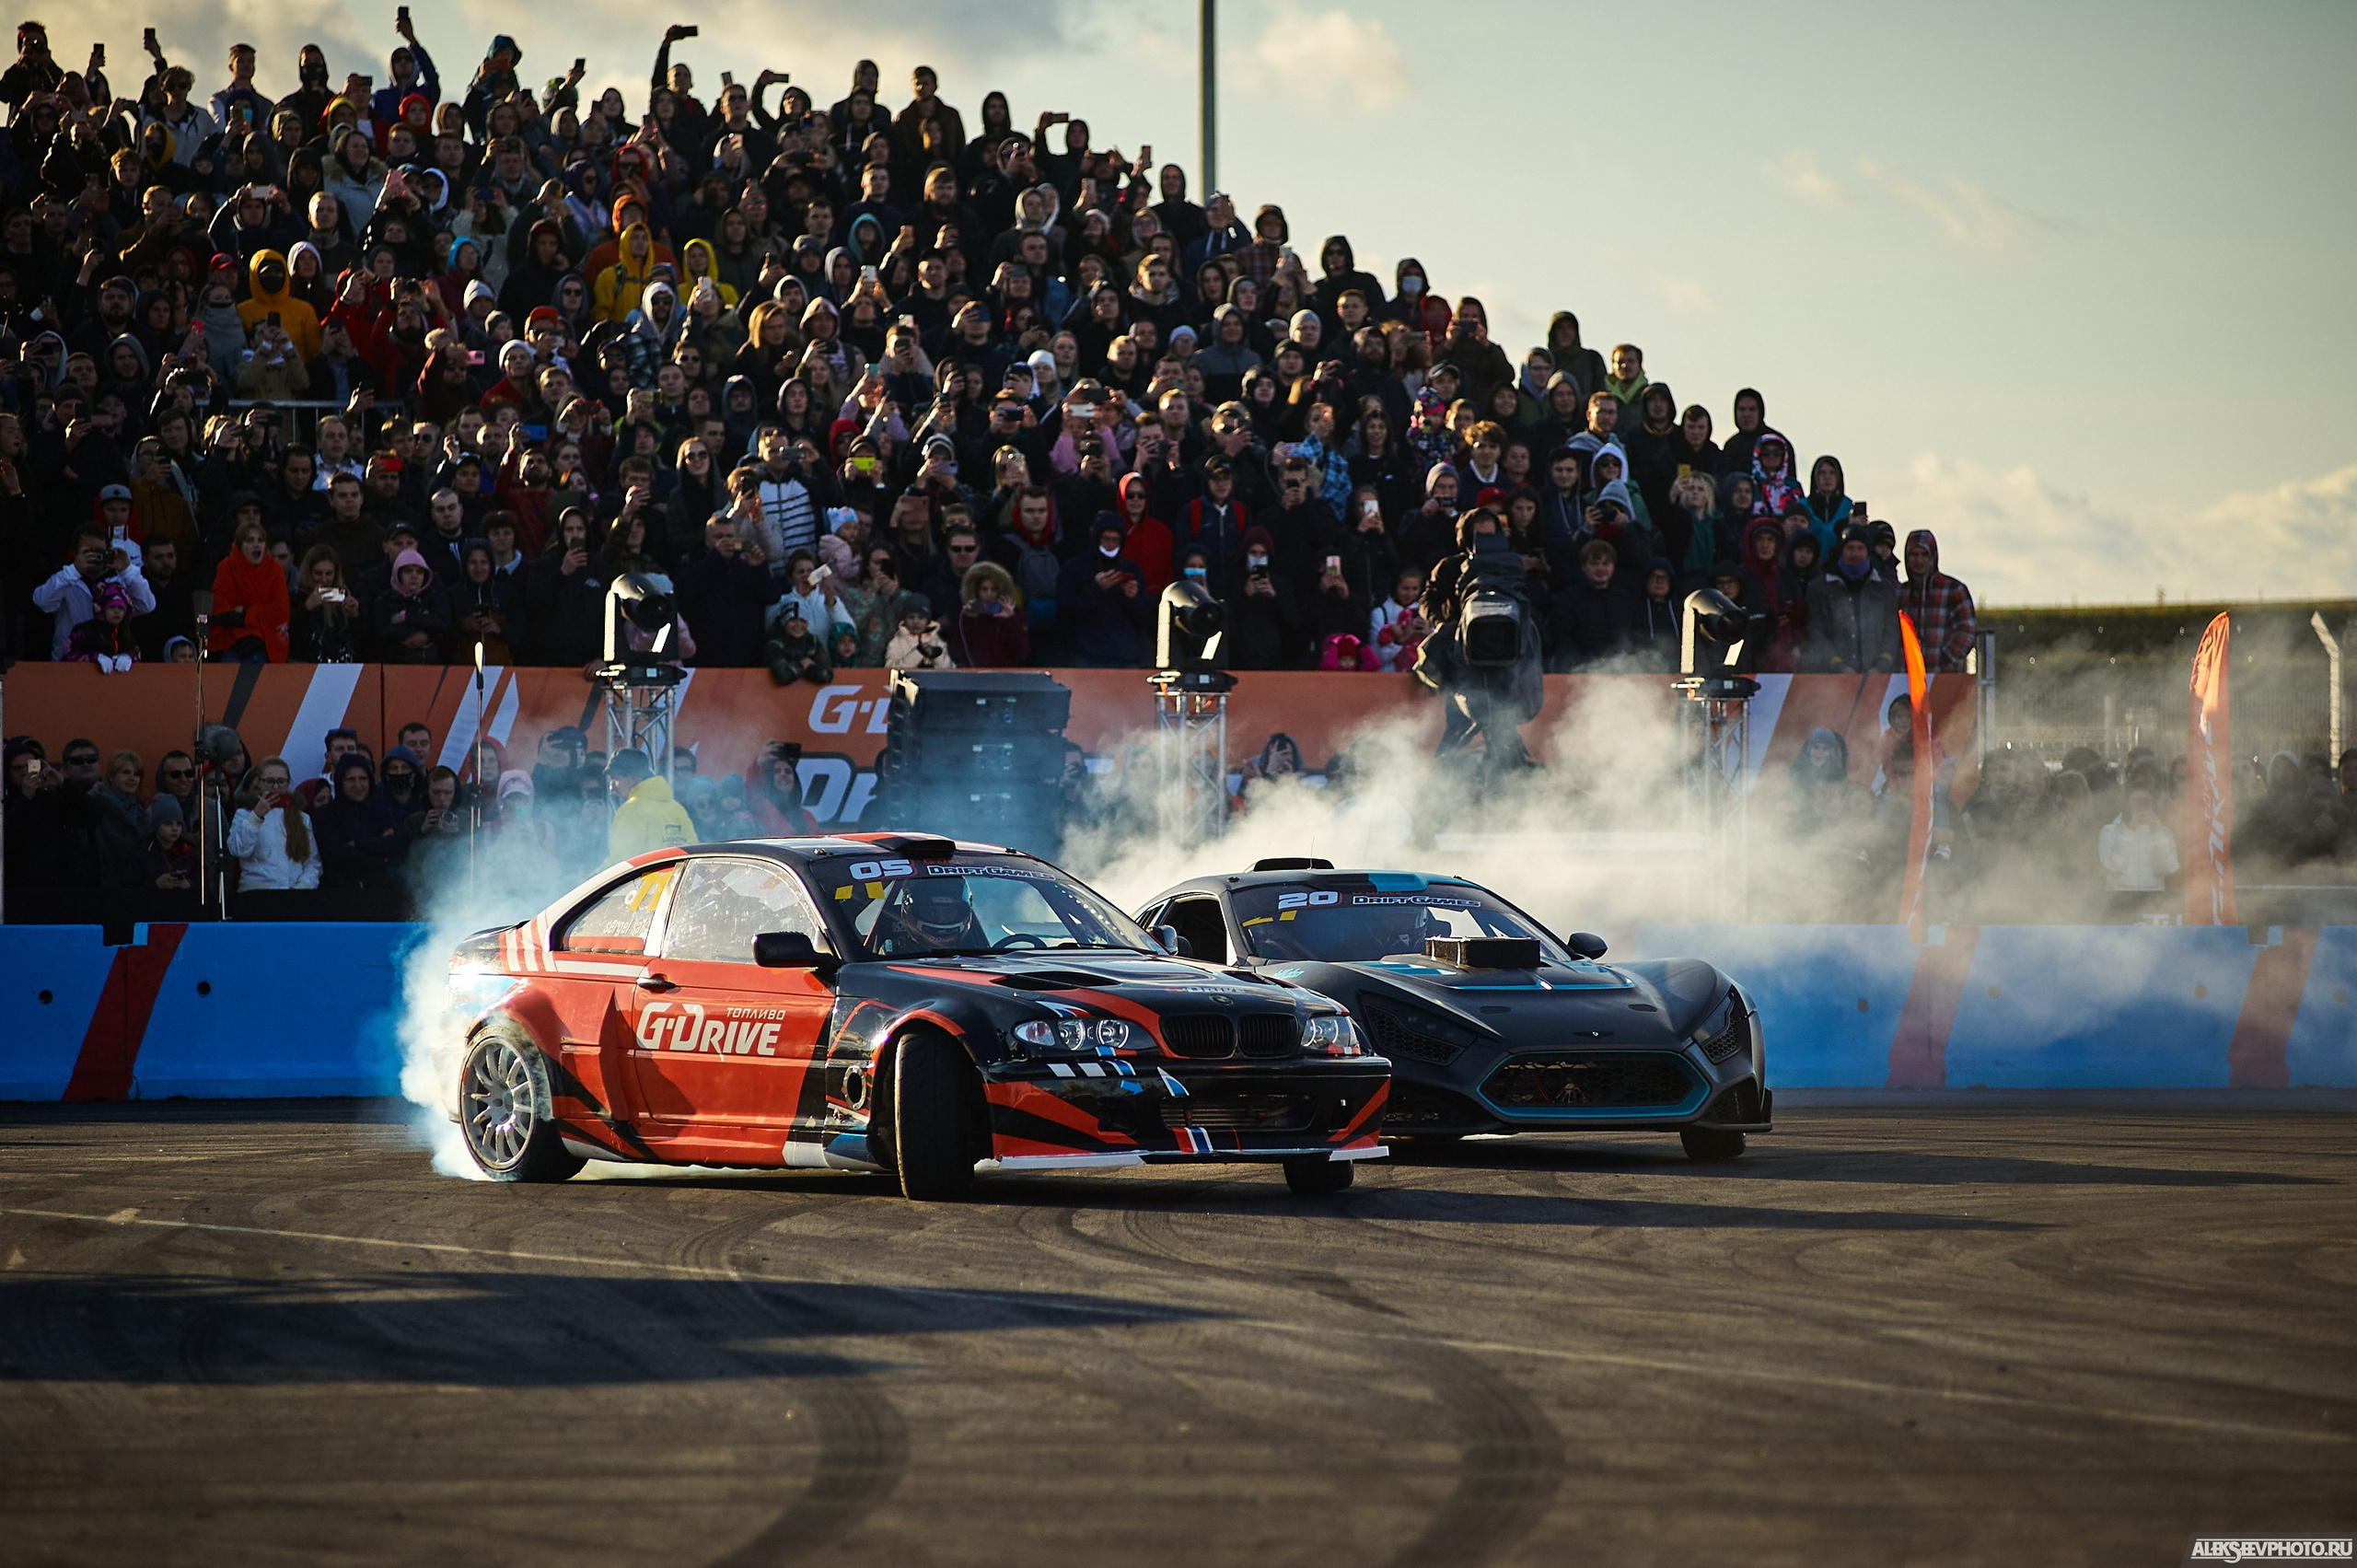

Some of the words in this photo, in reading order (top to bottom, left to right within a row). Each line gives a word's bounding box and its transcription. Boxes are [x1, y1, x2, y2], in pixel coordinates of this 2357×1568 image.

[850, 859, 913, 880] 05
[1278, 891, 1339, 910] 20
[726, 1007, 785, 1020] ТОПЛИВО
